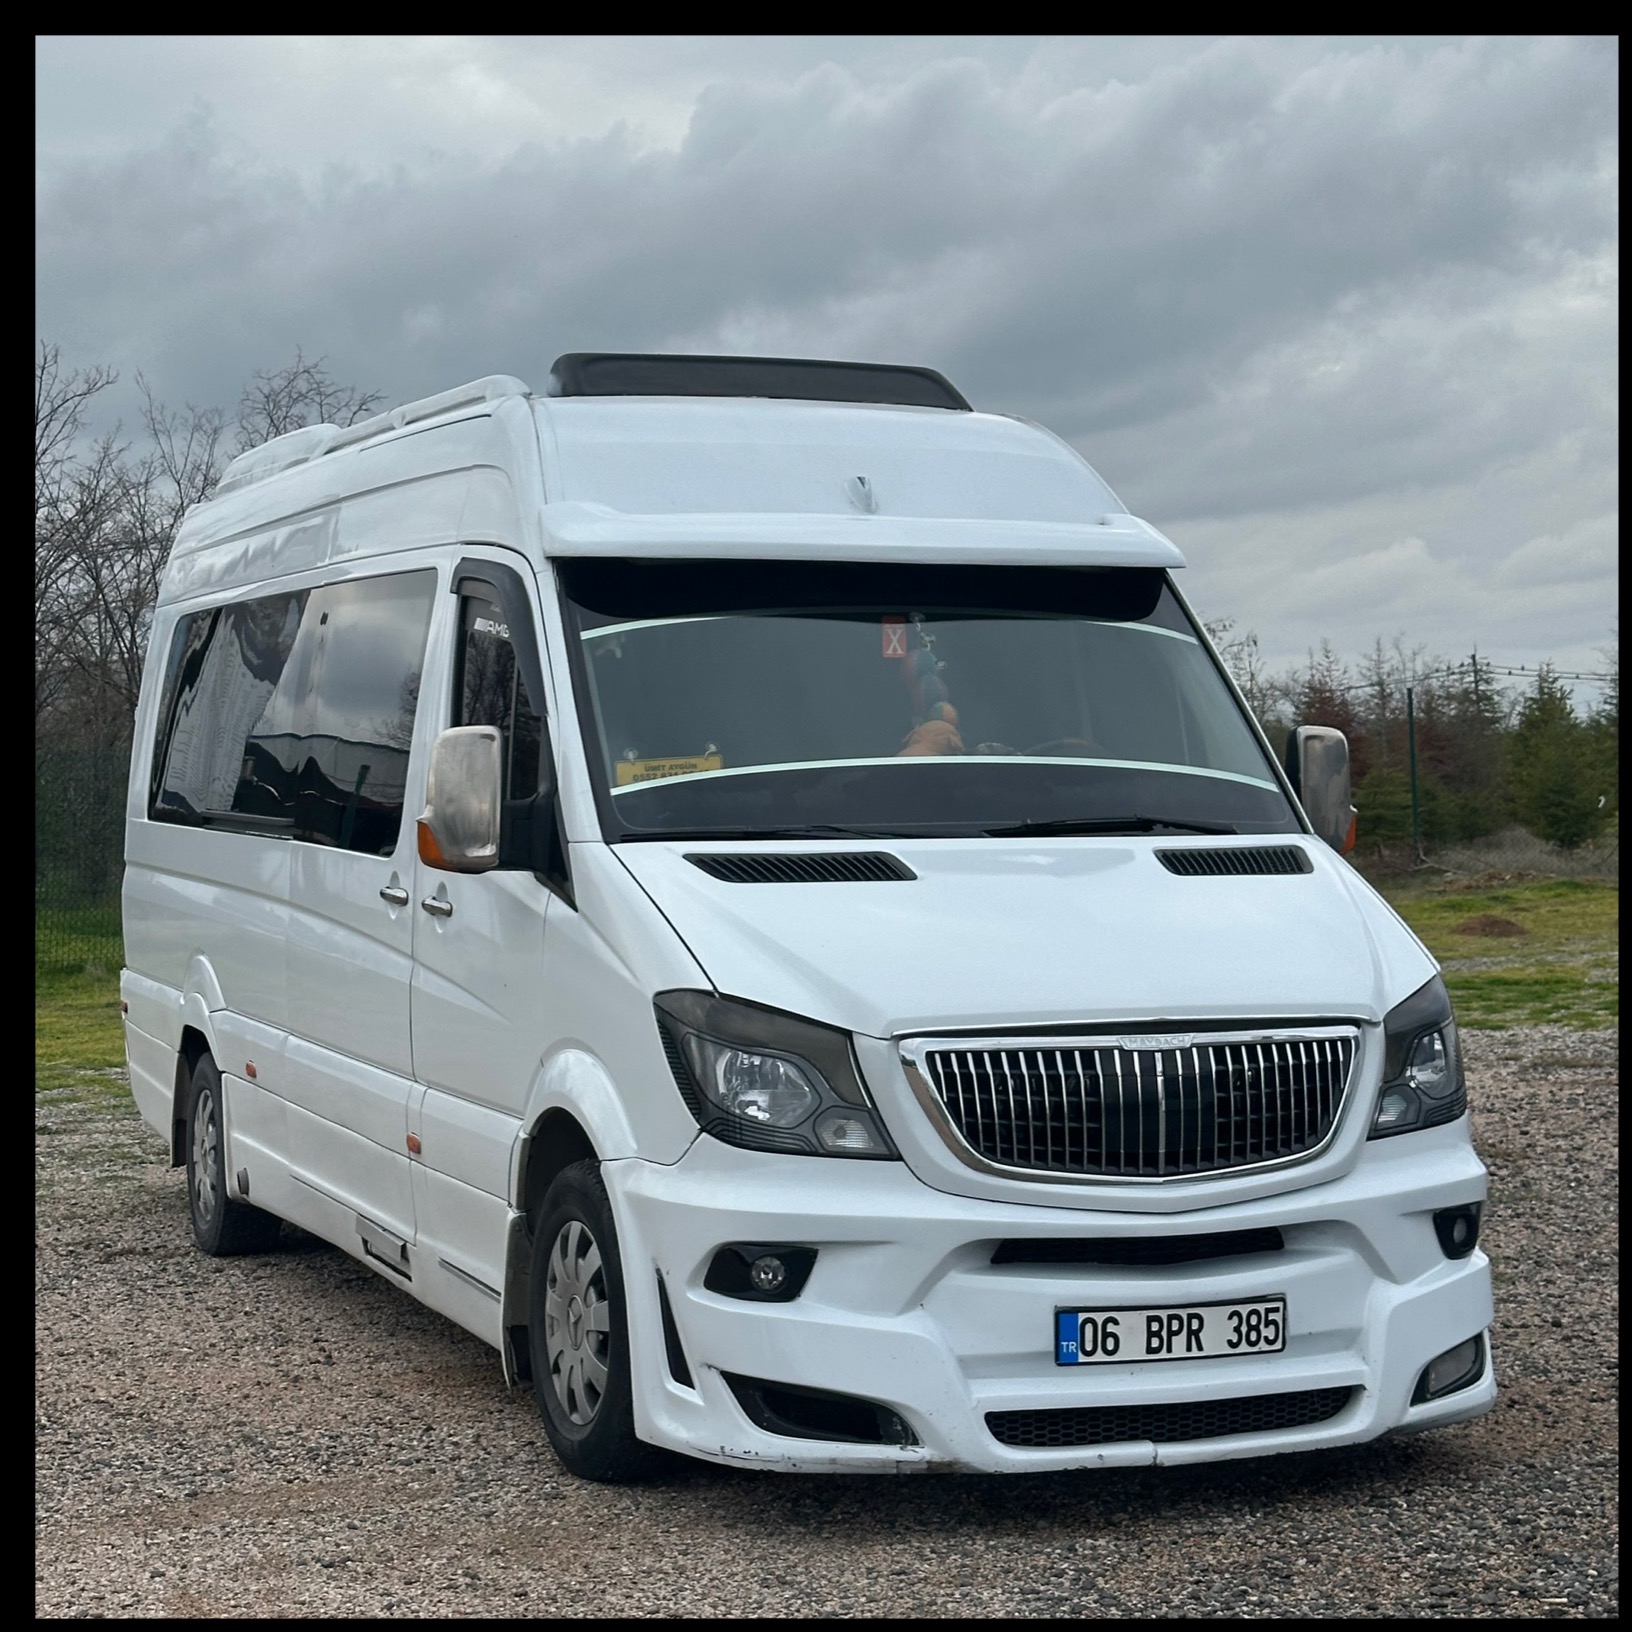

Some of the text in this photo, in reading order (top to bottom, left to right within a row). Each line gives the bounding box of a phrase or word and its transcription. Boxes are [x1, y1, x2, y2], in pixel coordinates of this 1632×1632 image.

[668, 760, 698, 771] AYGÜN
[1128, 1036, 1186, 1047] MAYBACH
[1061, 1306, 1281, 1357] TR 06 BPR 385
